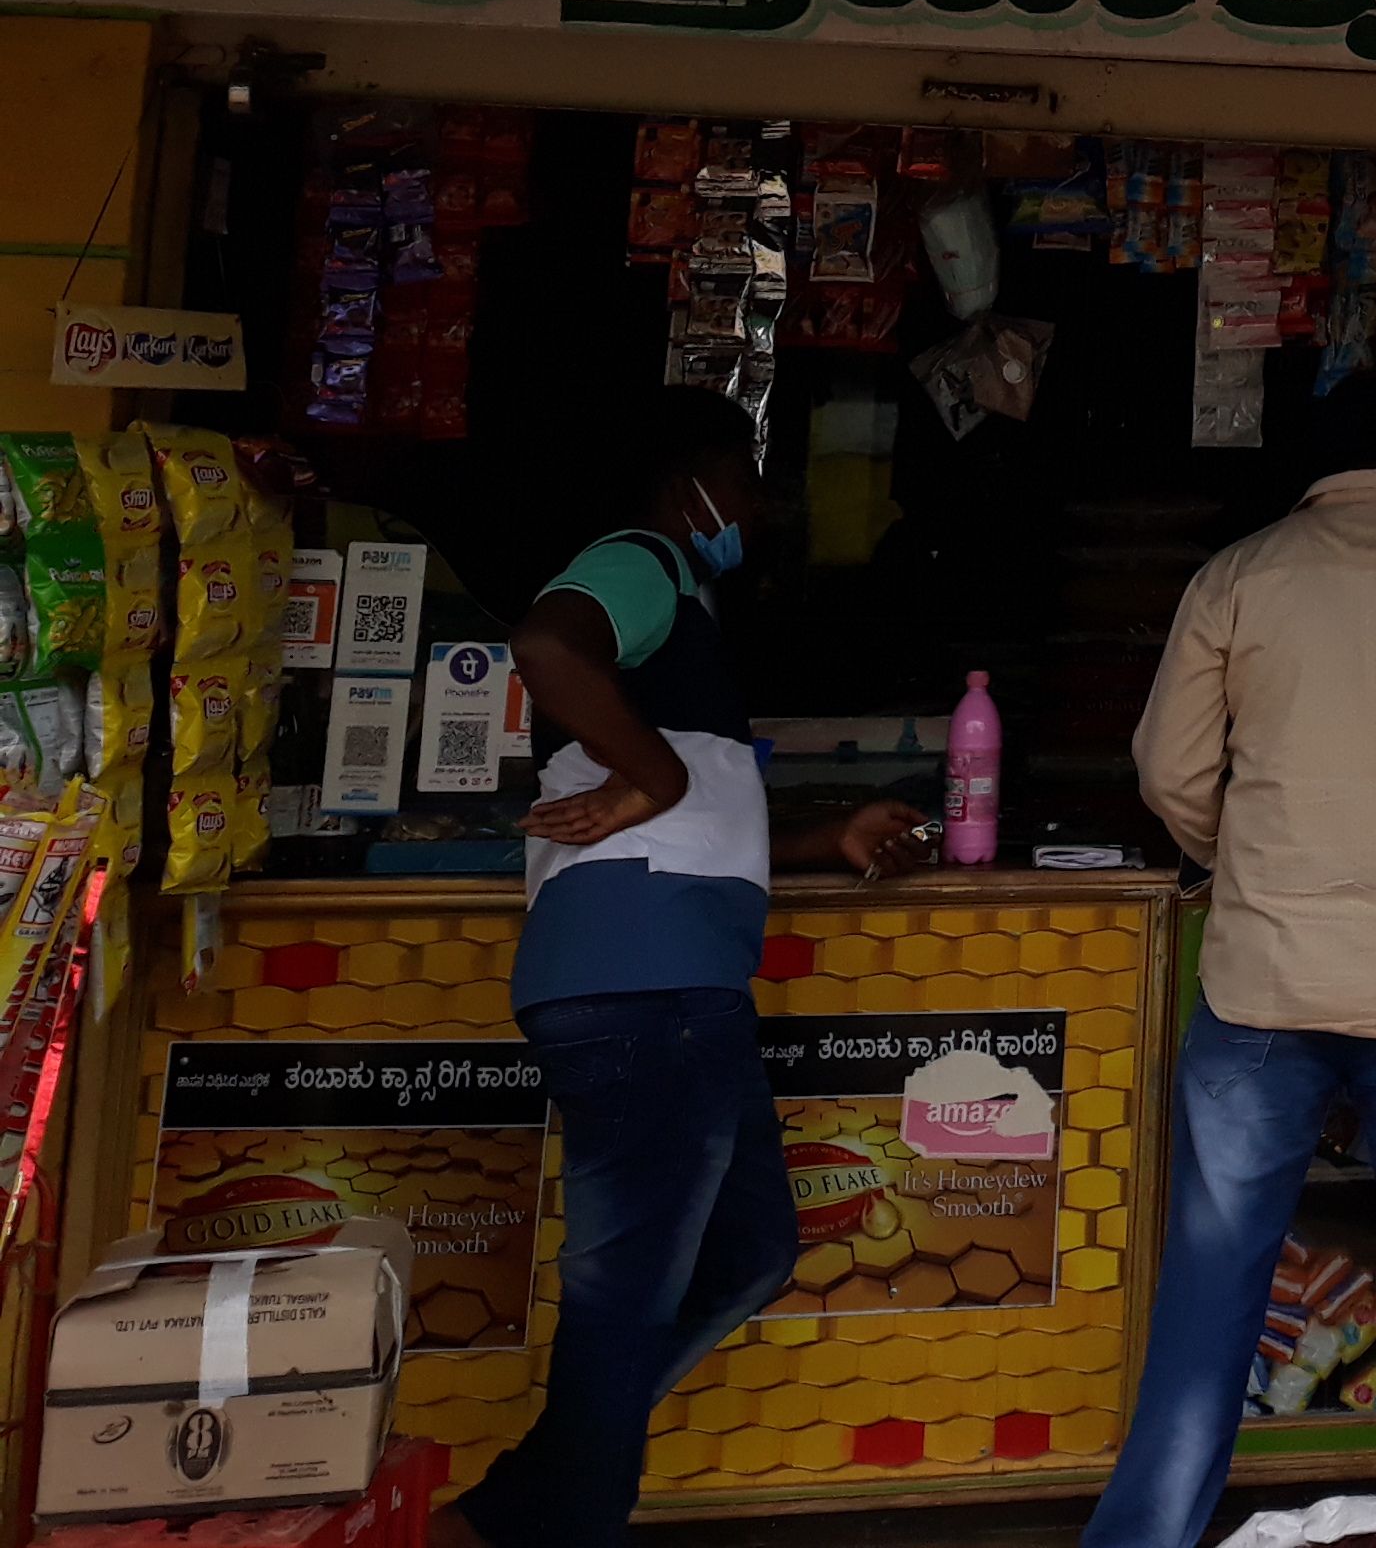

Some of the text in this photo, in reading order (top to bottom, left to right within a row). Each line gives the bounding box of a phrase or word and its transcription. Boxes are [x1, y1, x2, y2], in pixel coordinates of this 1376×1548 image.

[816, 1030, 902, 1060] ತಂಬಾಕು
[996, 1028, 1057, 1058] ಕಾರಣ
[284, 1060, 375, 1090] ತಂಬಾಕು
[381, 1059, 473, 1107] ಕ್ಯಾನ್ಸರಿಗೆ
[476, 1059, 542, 1089] ಕಾರಣ
[821, 1168, 881, 1194] FLAKE
[904, 1166, 1047, 1192] It's Honeydew
[406, 1203, 526, 1231] Honeydew
[932, 1194, 1015, 1219] Smooth
[184, 1212, 272, 1244] GOLD
[164, 1315, 204, 1329] NATAKA
[299, 1306, 327, 1322] KALS
